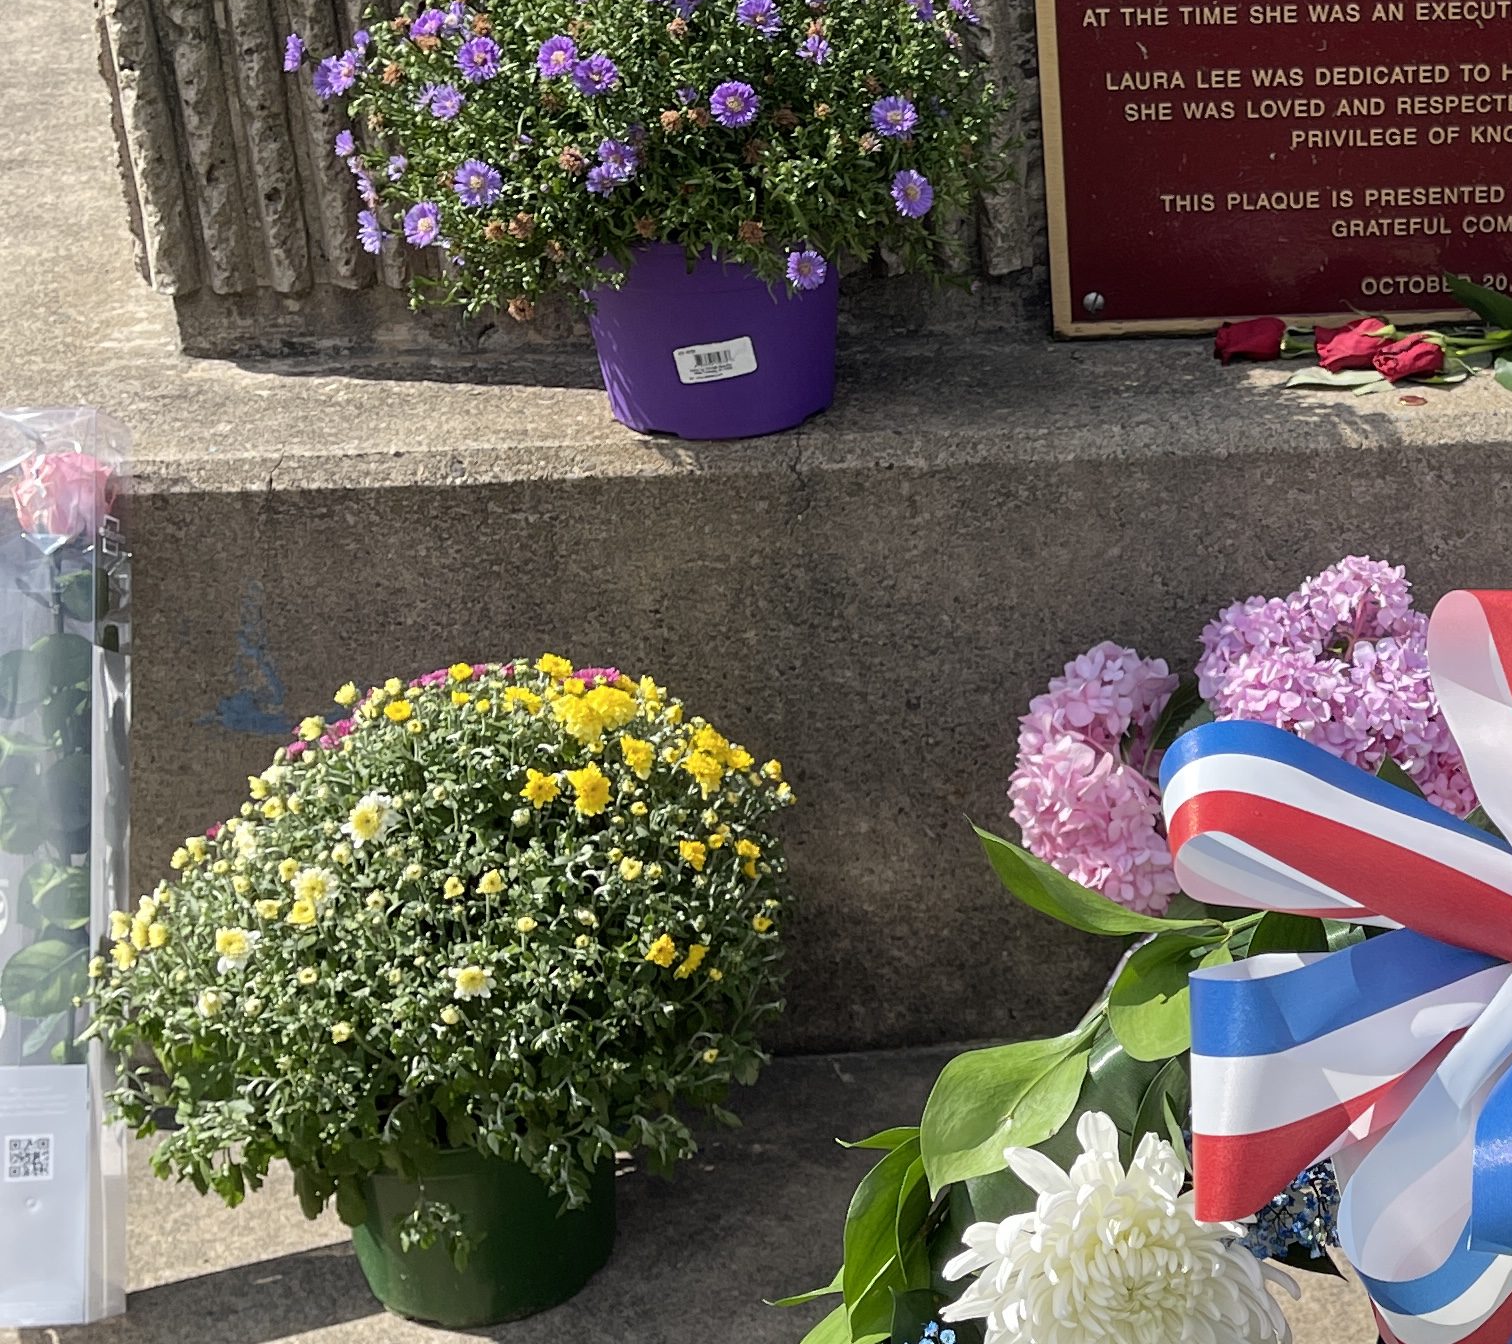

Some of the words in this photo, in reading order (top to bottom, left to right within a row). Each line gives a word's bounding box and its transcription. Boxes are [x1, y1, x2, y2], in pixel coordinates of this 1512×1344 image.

[1082, 8, 1111, 27] AT
[1119, 7, 1169, 26] THE
[1178, 5, 1238, 25] TIME
[1249, 4, 1298, 24] SHE
[1307, 3, 1361, 23] WAS
[1371, 2, 1404, 22] AN
[1106, 71, 1186, 91] LAURA
[1196, 69, 1242, 89] LEE
[1251, 68, 1304, 87] WAS
[1315, 65, 1450, 86] DEDICATED
[1459, 63, 1491, 82] TO
[1124, 102, 1173, 121] SHE
[1182, 101, 1235, 119] WAS
[1246, 98, 1326, 118] LOVED
[1335, 97, 1386, 116] AND
[1289, 127, 1418, 150] PRIVILEGE
[1428, 126, 1461, 145] OF
[1159, 194, 1216, 212] THIS
[1227, 190, 1321, 210] PLAQUE
[1331, 190, 1354, 208] IS
[1365, 185, 1505, 207] PRESENTED
[1331, 216, 1452, 238] GRATEFUL
